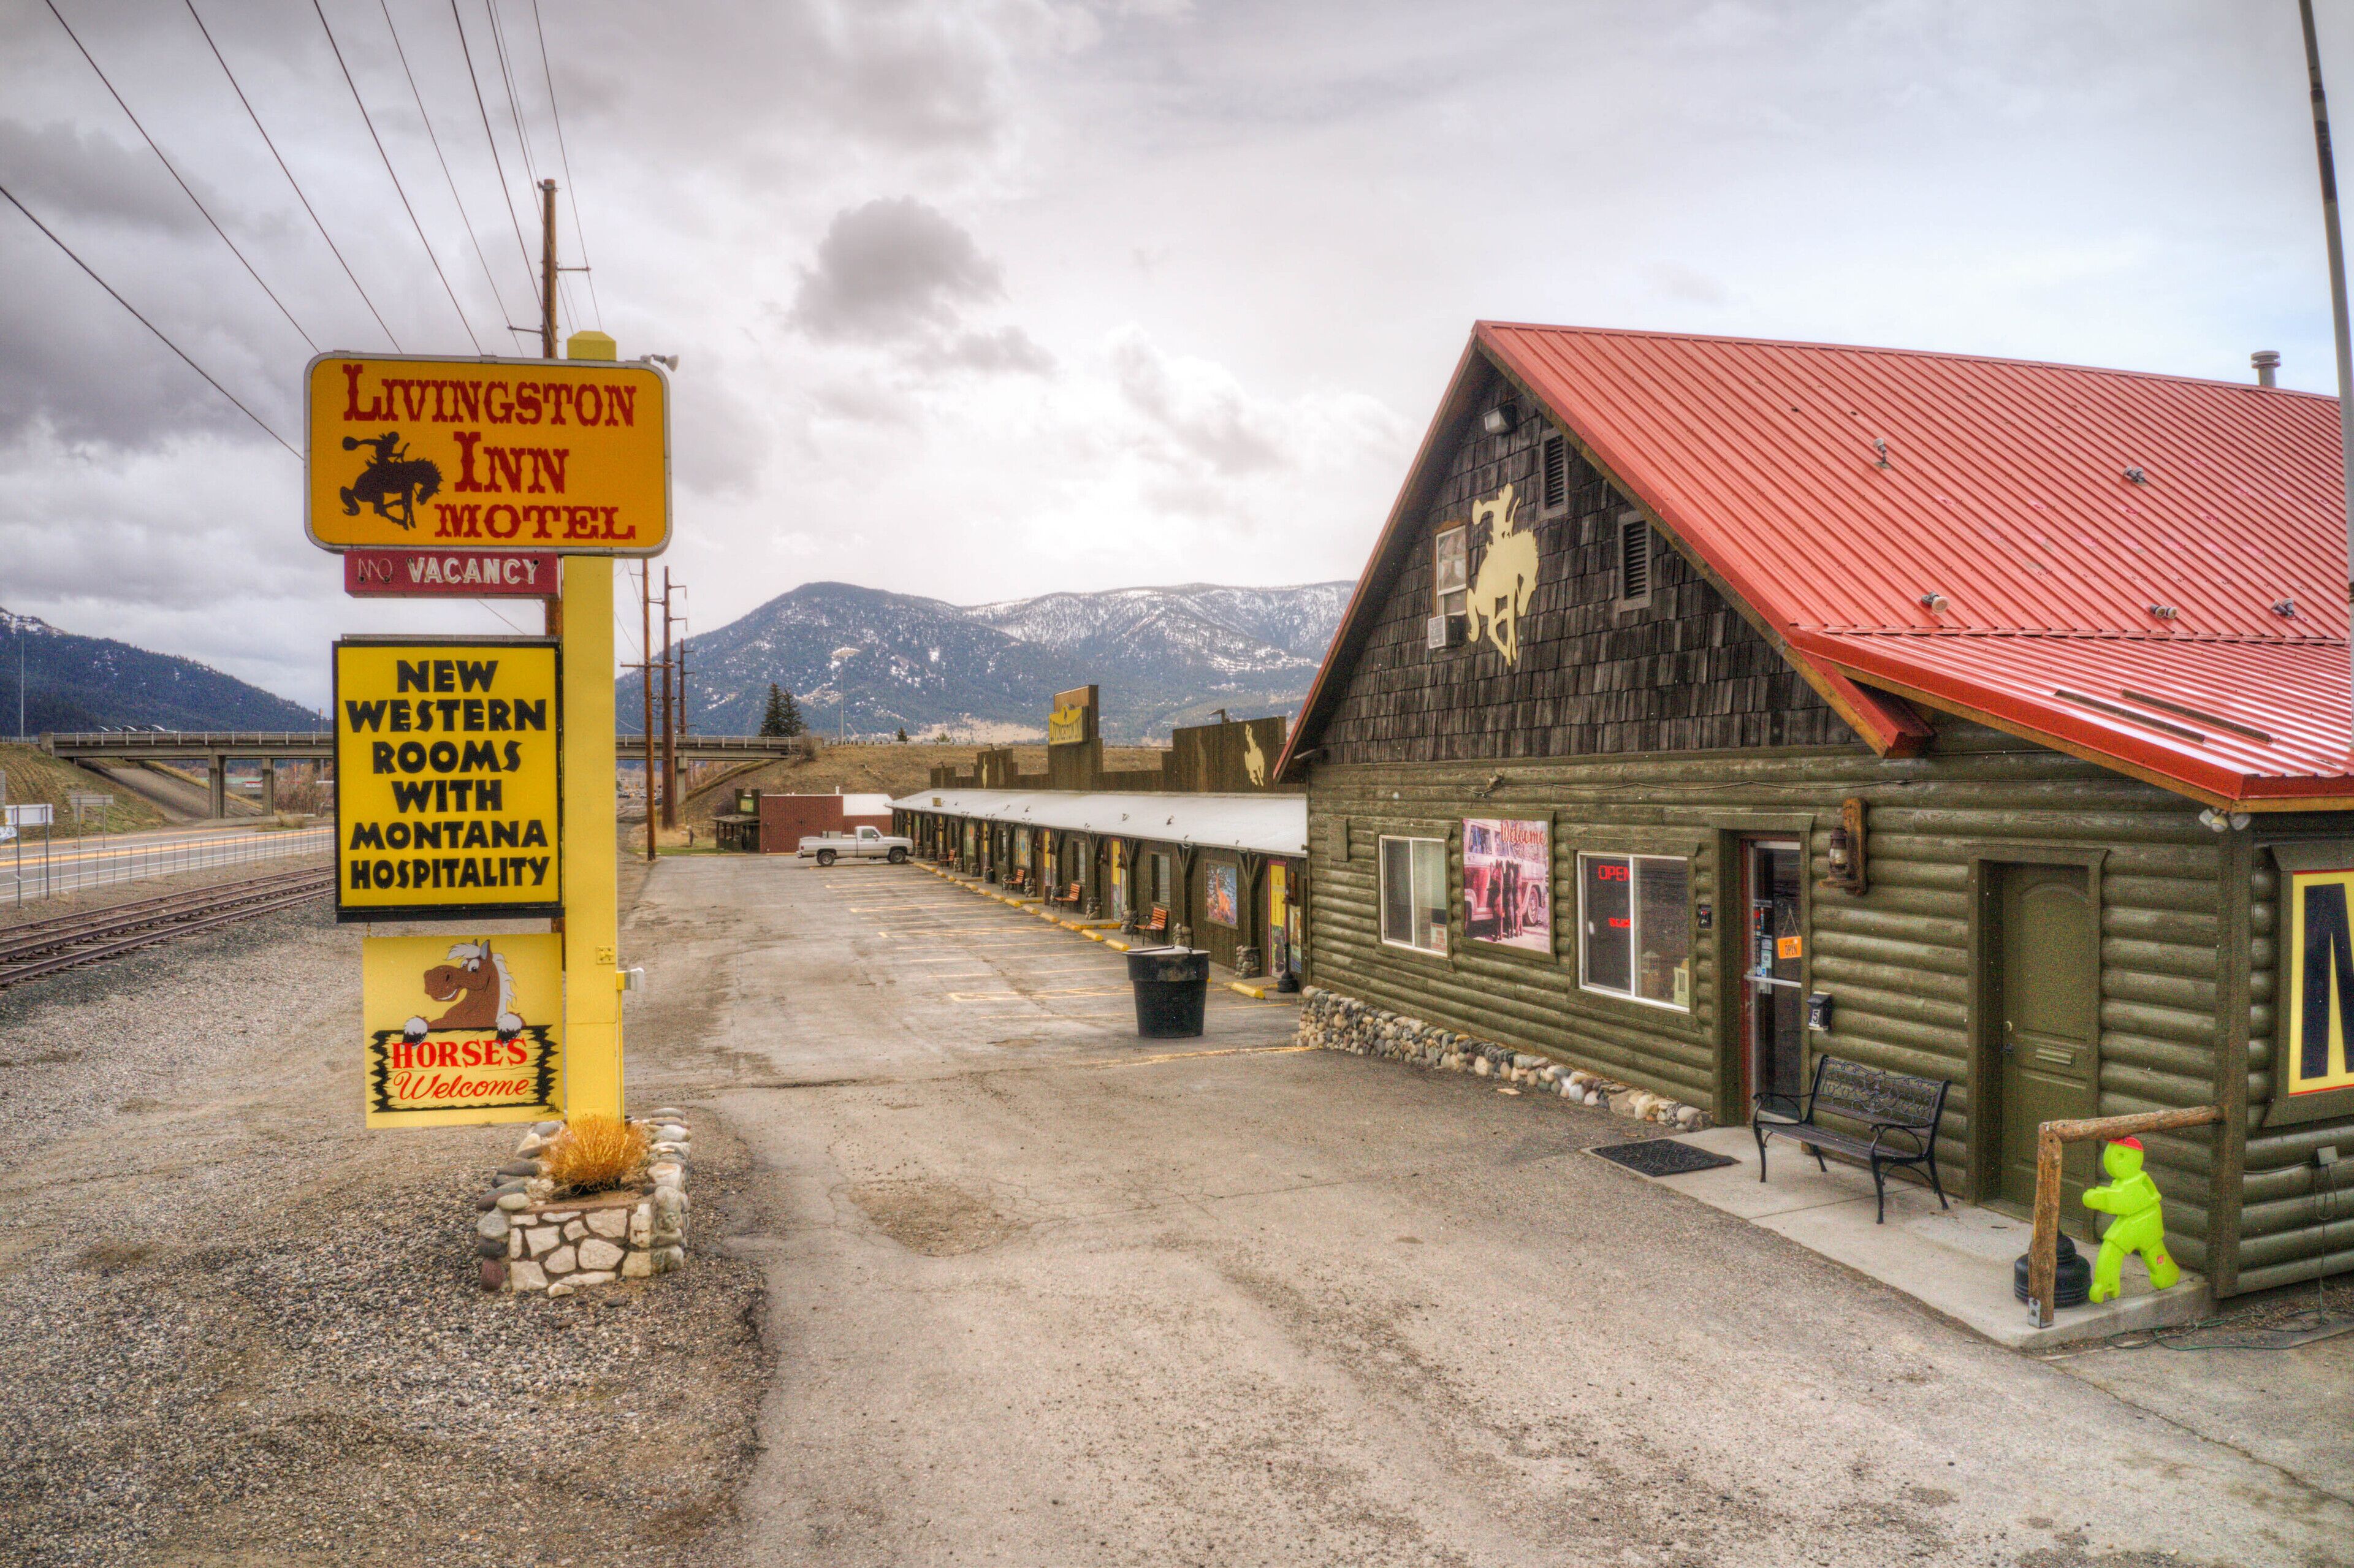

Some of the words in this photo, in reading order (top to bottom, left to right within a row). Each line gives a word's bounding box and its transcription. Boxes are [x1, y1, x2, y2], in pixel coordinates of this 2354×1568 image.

[342, 363, 636, 427] LIVINGSTON
[453, 431, 569, 494] INN
[434, 504, 636, 539] MOTEL
[358, 558, 394, 582] NO
[406, 557, 540, 584] VACANCY
[396, 660, 499, 693] NEW
[345, 698, 547, 733] WESTERN
[371, 740, 524, 775] ROOMS
[391, 778, 503, 813] WITH
[349, 819, 549, 851] MONTANA
[1500, 819, 1548, 845] Welcome
[350, 856, 551, 889] HOSPITALITY
[1598, 864, 1630, 882] OPEN
[1785, 943, 1797, 956] OPEN
[1812, 1010, 1819, 1022] 5
[391, 1038, 528, 1069] HORSES
[393, 1070, 530, 1101] Welcome
